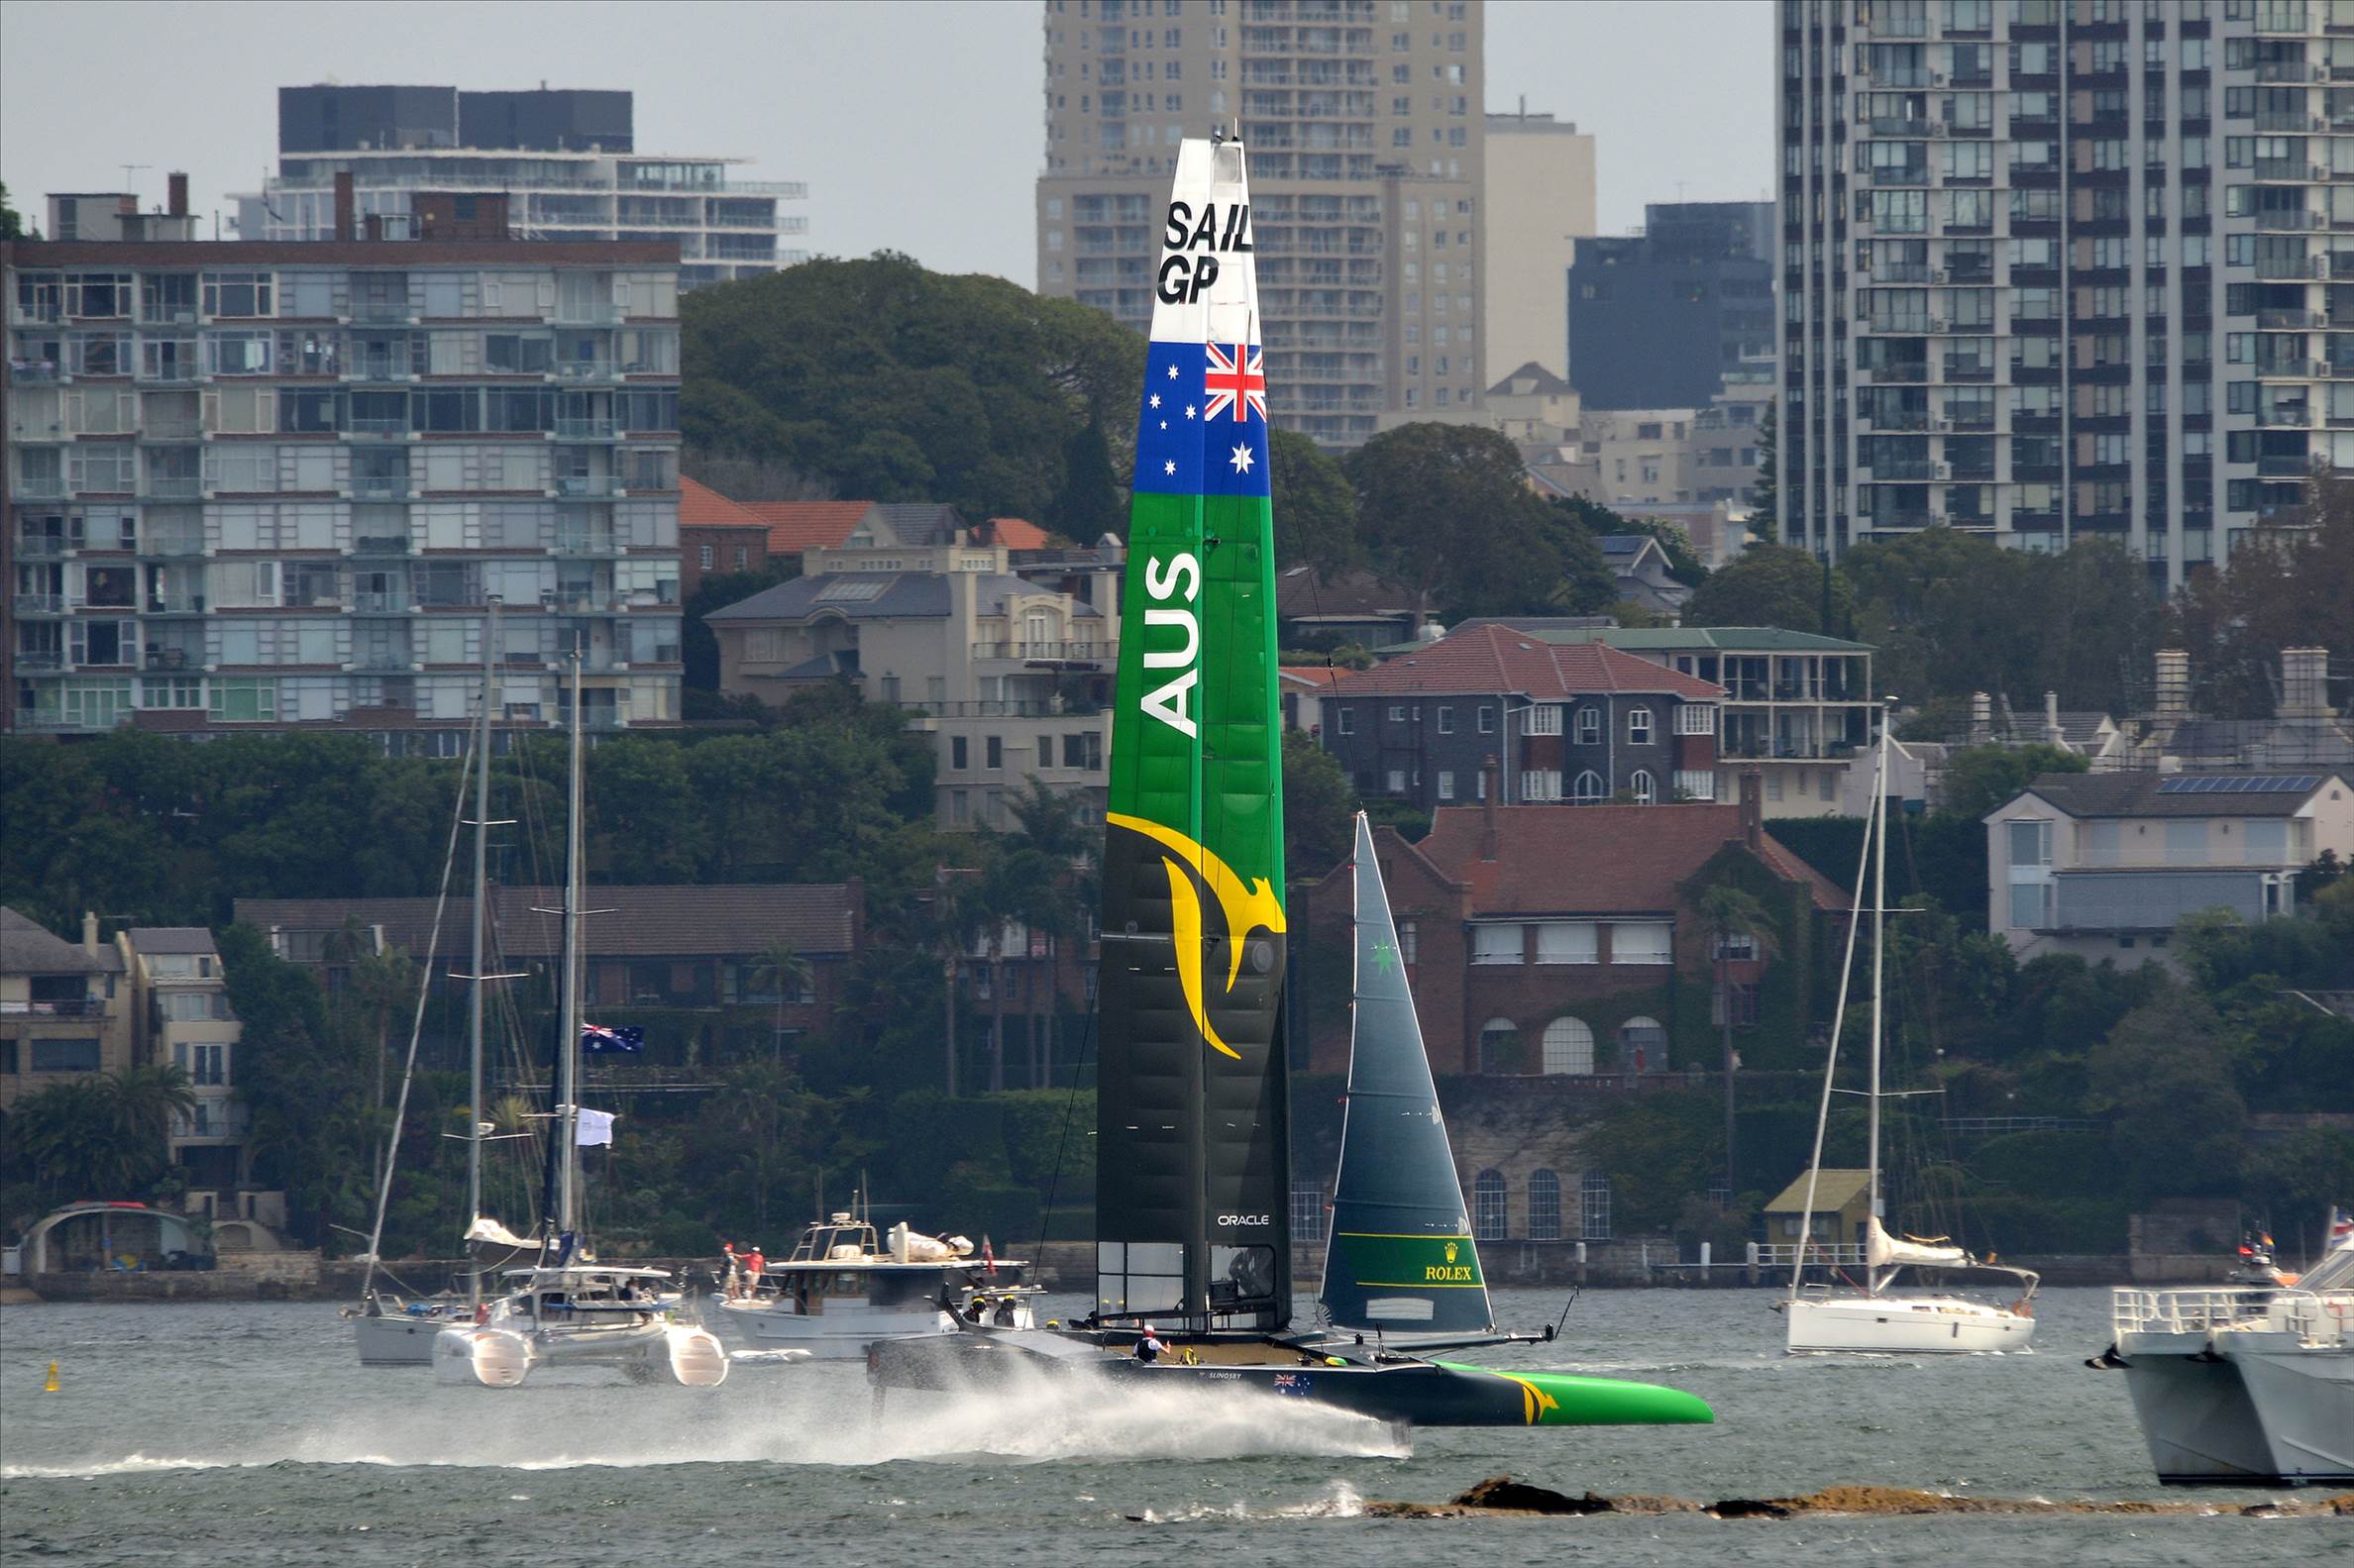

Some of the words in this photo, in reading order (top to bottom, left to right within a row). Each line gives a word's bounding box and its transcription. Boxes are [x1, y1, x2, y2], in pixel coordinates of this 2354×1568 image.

[1163, 201, 1253, 253] SAIL
[1157, 255, 1220, 305] GP
[1140, 553, 1201, 739] AUS
[1218, 1214, 1269, 1225] ORACLE
[1425, 1267, 1472, 1281] ROLEX
